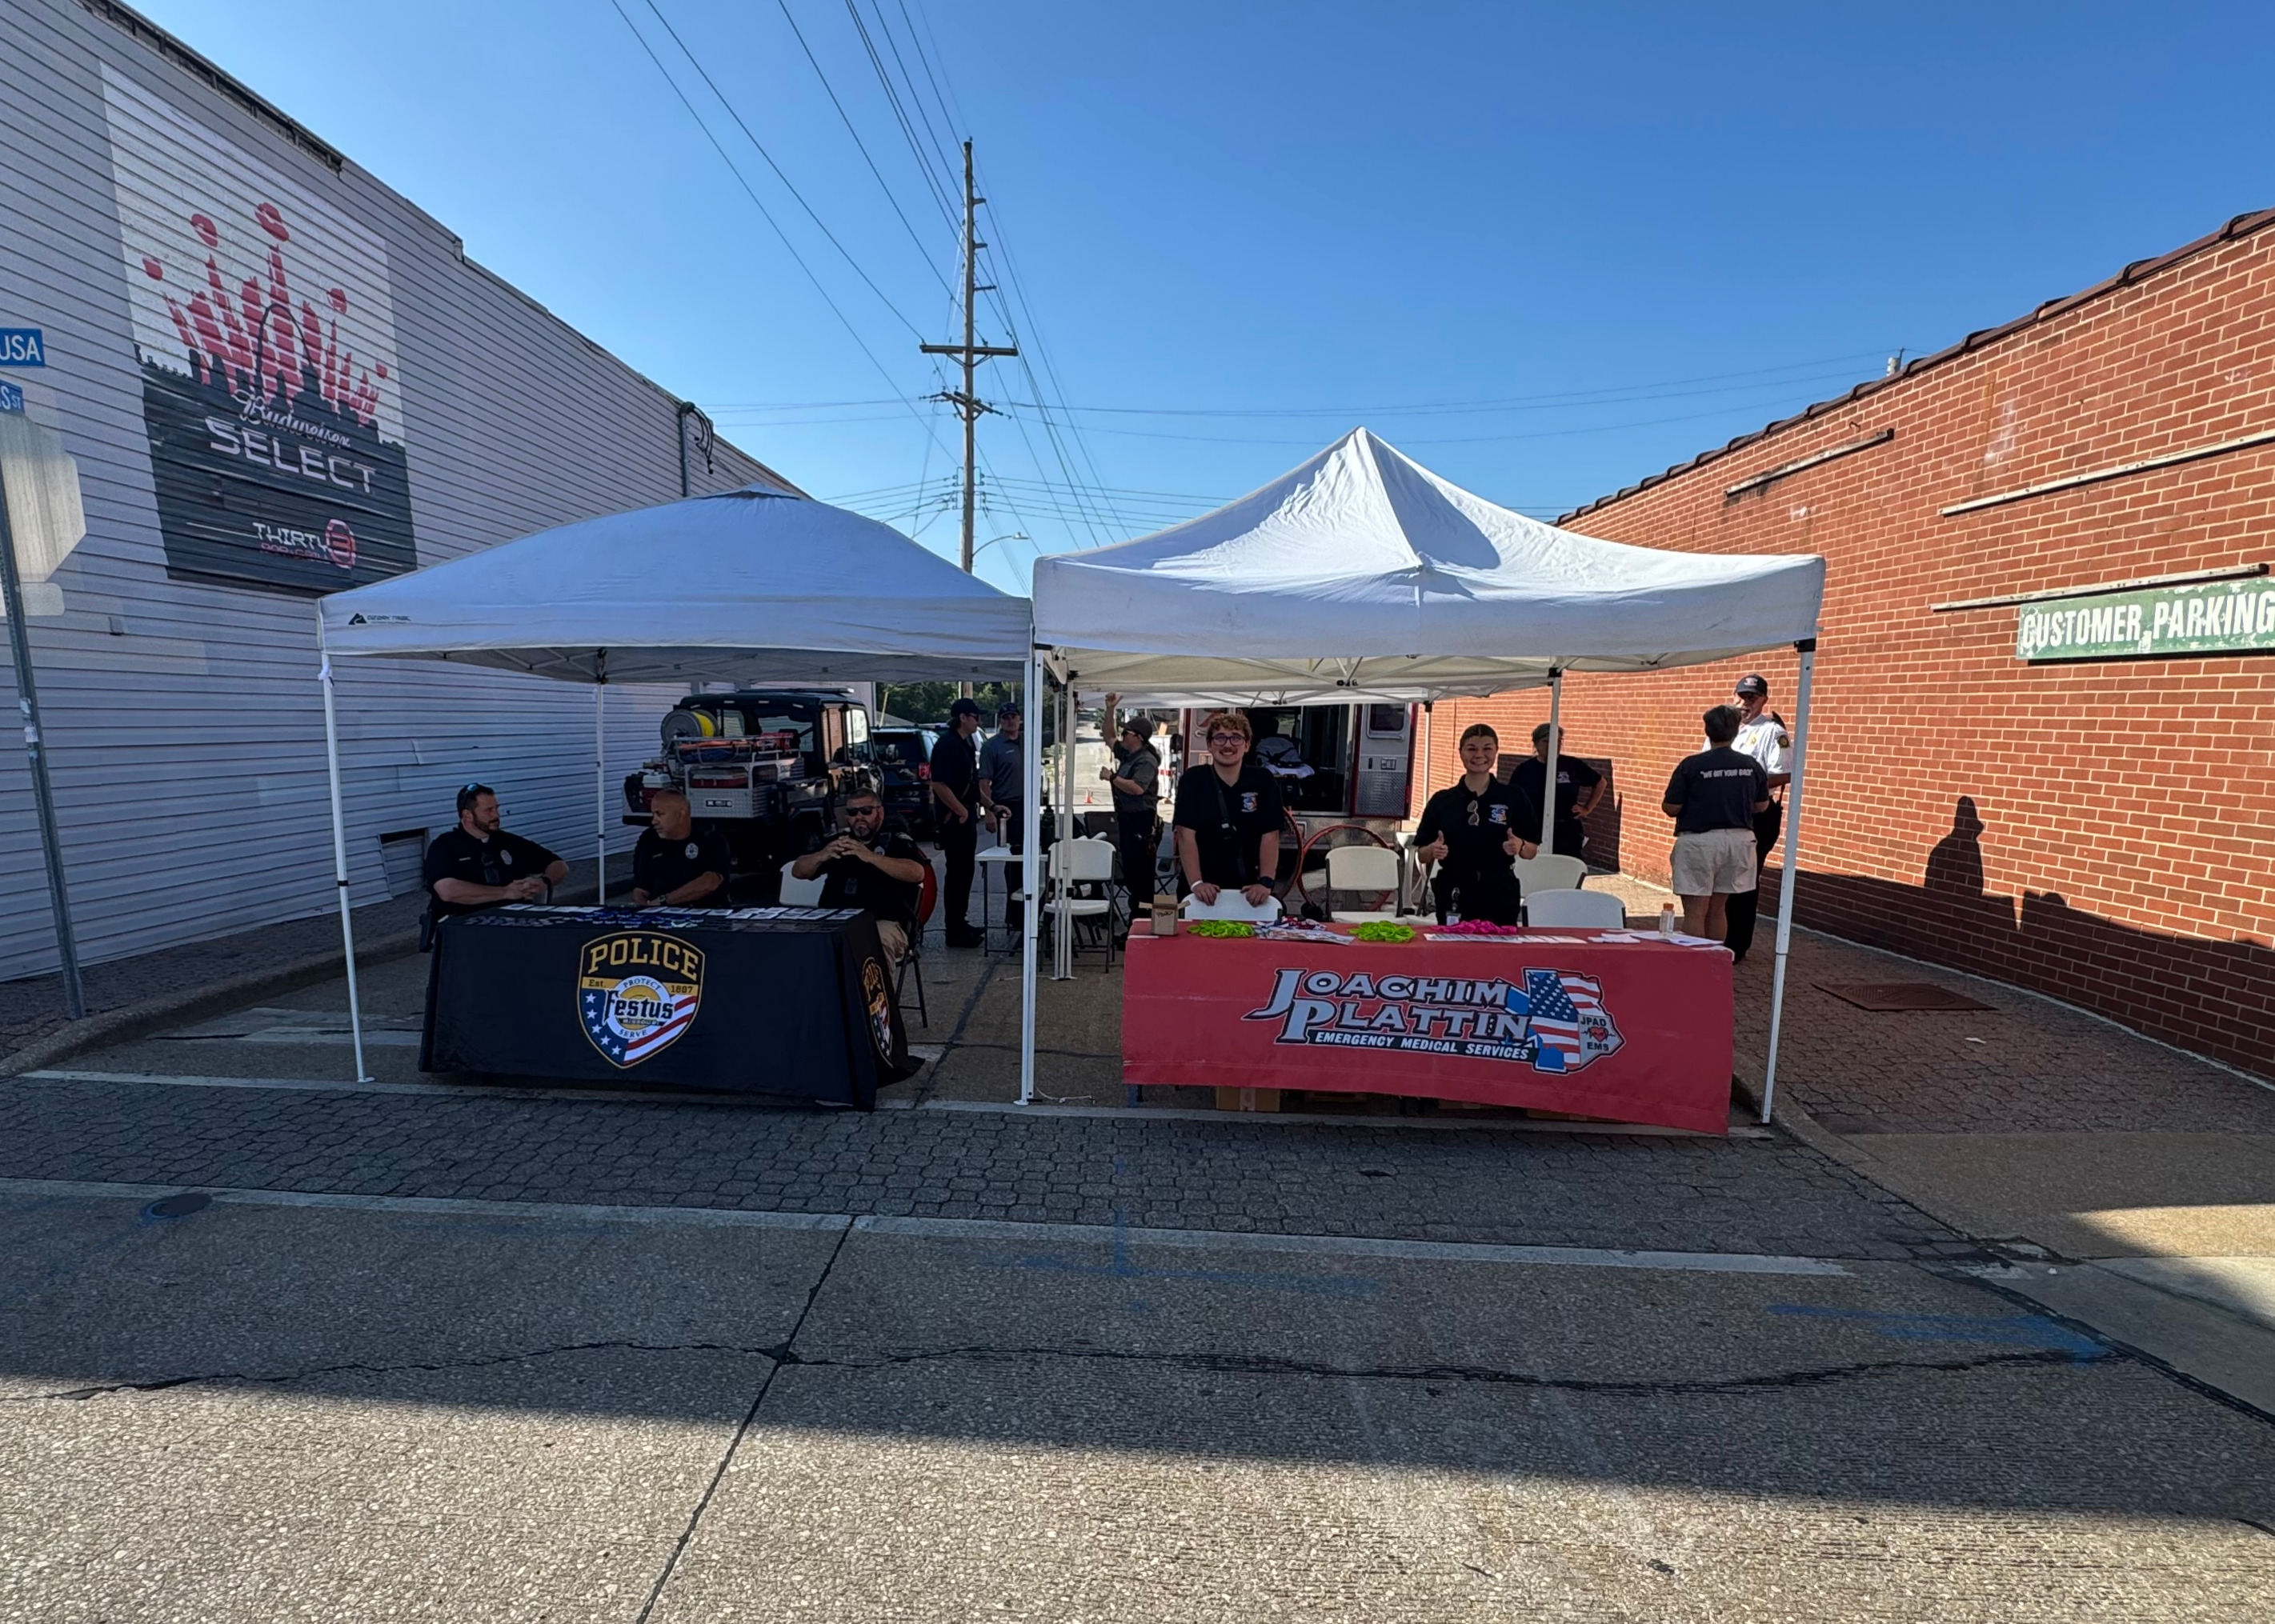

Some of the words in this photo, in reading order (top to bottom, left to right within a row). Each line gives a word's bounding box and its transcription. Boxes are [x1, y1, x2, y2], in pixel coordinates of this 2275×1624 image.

[11, 394, 22, 410] ST
[230, 389, 351, 450] Budweiser
[205, 415, 376, 494] SELECT
[252, 522, 329, 553] THIRTY
[2022, 603, 2142, 649] CUSTOMER
[2153, 590, 2275, 639] PARKING
[587, 938, 699, 982] POLICE
[588, 979, 607, 988] Est.
[623, 978, 661, 990] PROTECT
[1242, 968, 1512, 1019] JOACHIM
[603, 990, 674, 1023] Festus
[1276, 998, 1530, 1044] PLATTIN
[1580, 1016, 1607, 1026] JPAD
[619, 1029, 647, 1038] SERVE
[1315, 1032, 1393, 1047] EMERGENCY
[1400, 1038, 1458, 1053] MEDICAL
[1465, 1044, 1529, 1059] SERVICES
[1587, 1042, 1609, 1051] EMS
